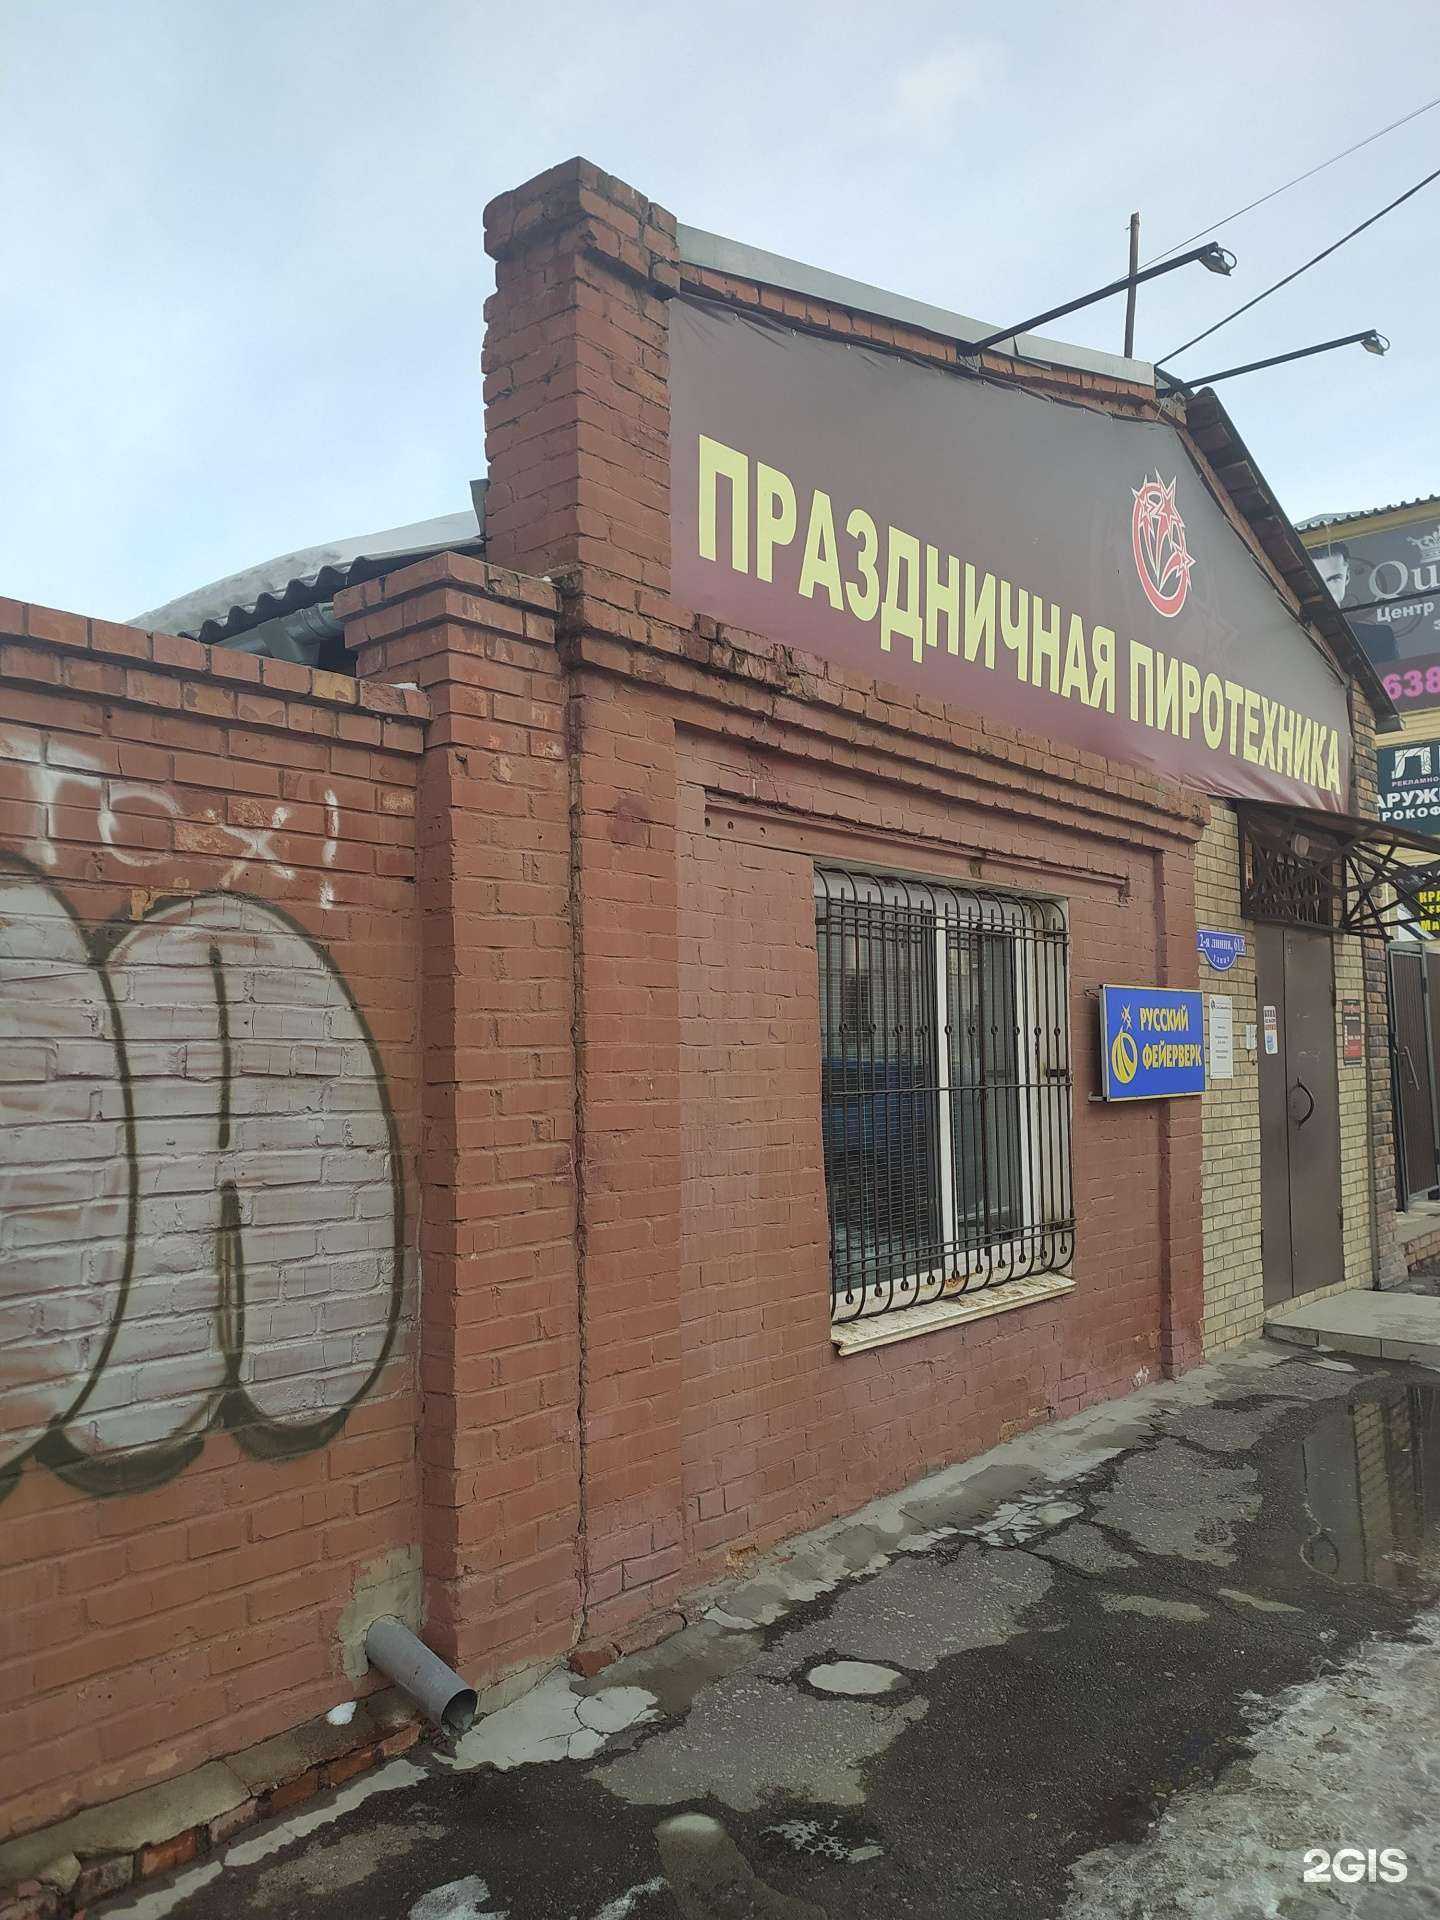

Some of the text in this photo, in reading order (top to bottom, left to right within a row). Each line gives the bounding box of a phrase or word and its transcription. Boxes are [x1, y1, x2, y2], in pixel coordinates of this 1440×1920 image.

[698, 434, 1342, 795] ПРАЗДНИЧНАЯ ПИРОТЕХНИКА
[1376, 601, 1435, 622] Центр
[1391, 776, 1440, 788] РЕКЛАМНО
[1377, 787, 1440, 809] АРУЖ
[1377, 806, 1440, 822] РОКОФ
[1140, 1003, 1189, 1032] РУССКИЙ
[1142, 1039, 1202, 1070] ФЕЙЕРВЕРК
